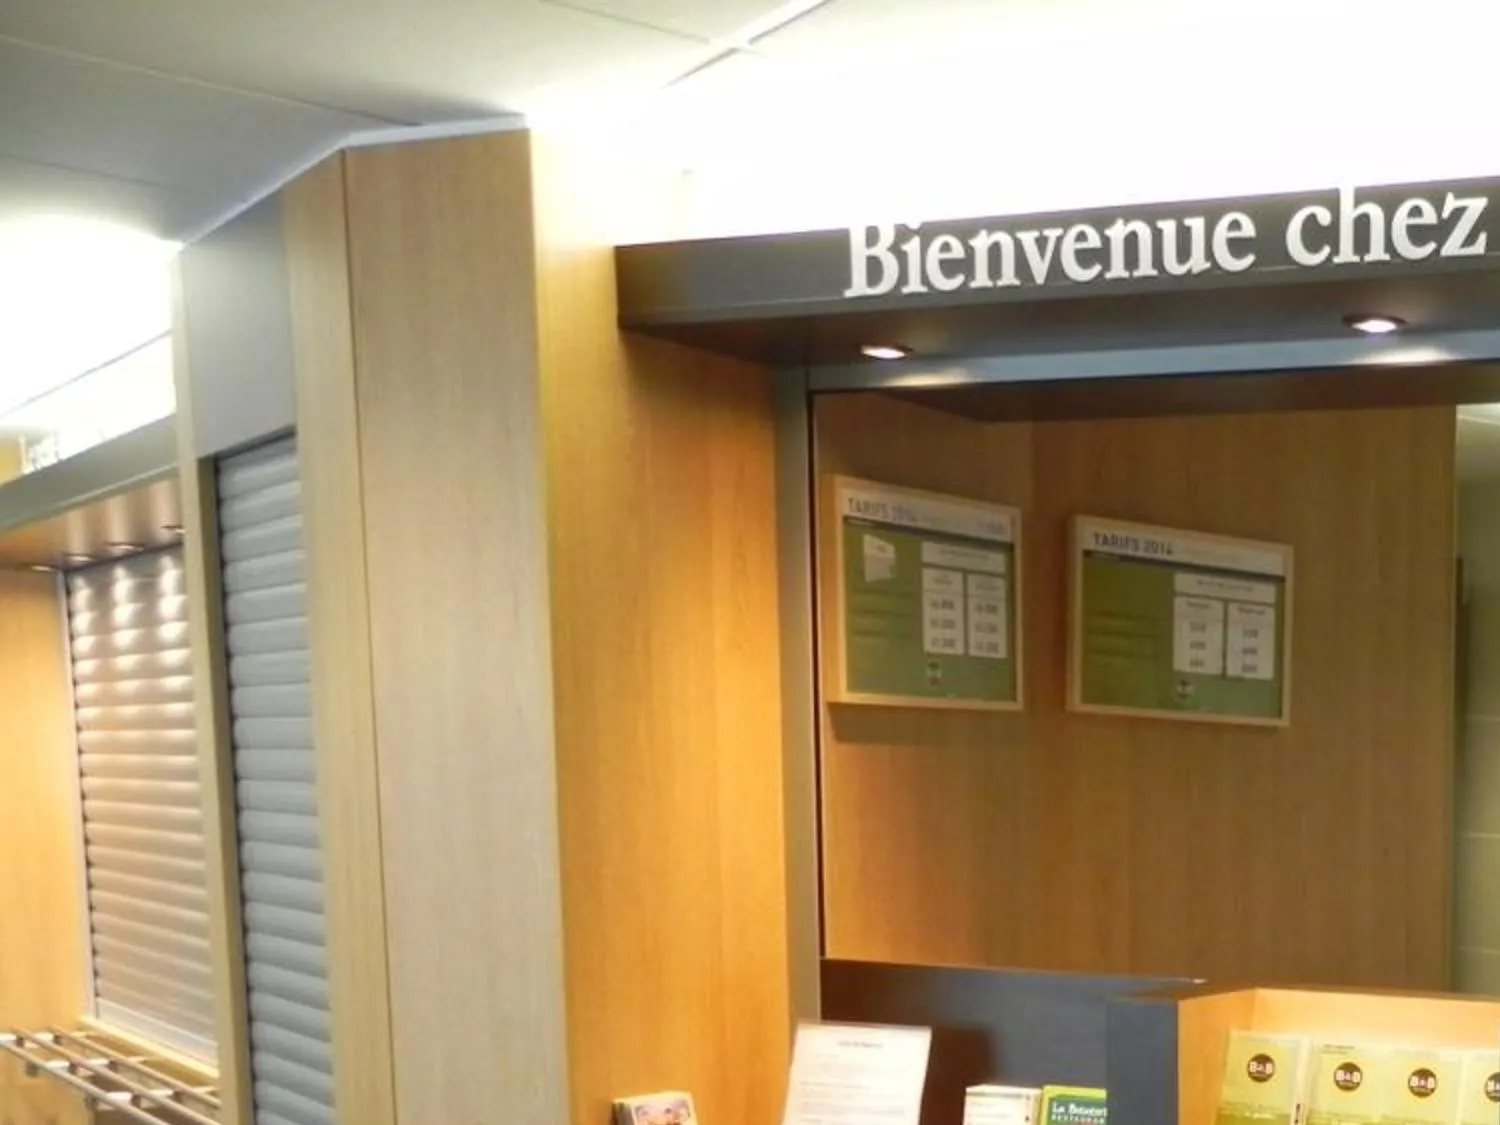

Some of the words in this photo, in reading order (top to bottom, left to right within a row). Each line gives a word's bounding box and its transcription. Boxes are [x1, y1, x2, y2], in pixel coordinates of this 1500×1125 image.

[843, 211, 1257, 298] Bienvenue
[1285, 183, 1489, 266] chez
[1094, 531, 1139, 553] TARIFS
[1144, 538, 1174, 556] 2014
